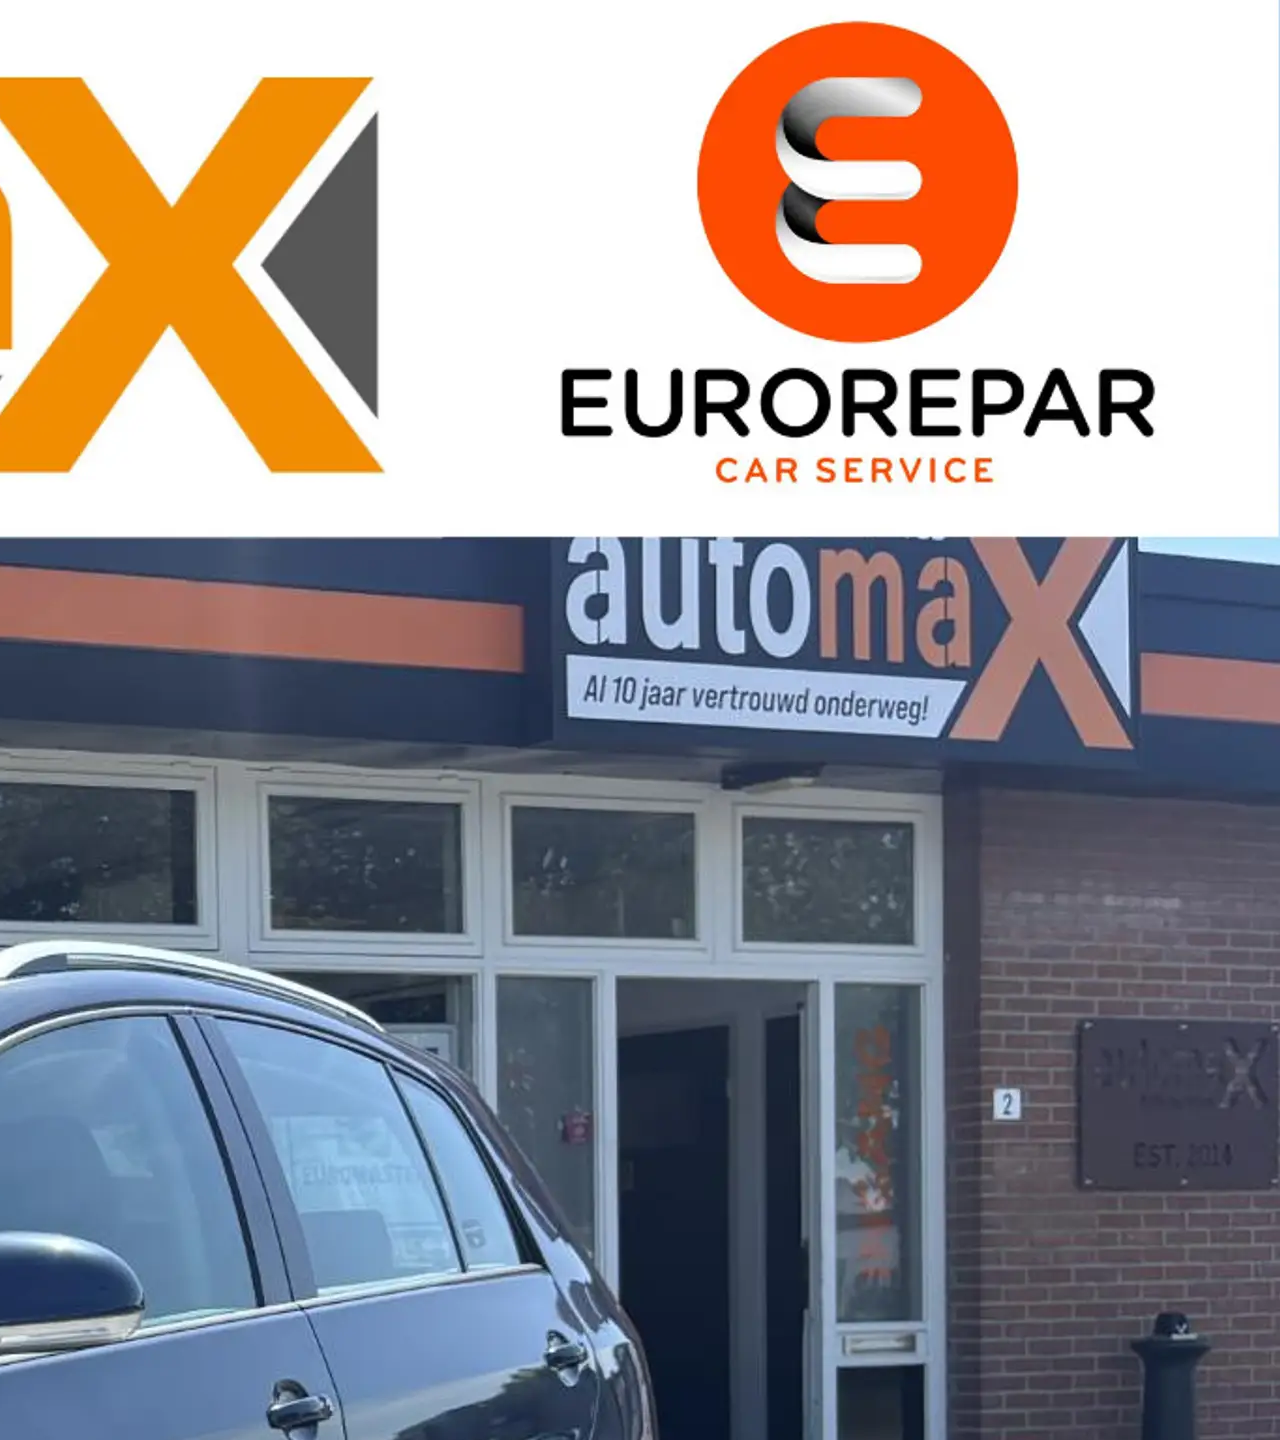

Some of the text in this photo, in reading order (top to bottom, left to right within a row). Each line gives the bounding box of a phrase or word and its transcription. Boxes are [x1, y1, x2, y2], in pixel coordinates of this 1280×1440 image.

[584, 675, 929, 726] Al 10 jaar vertrouwd onderweg!
[1002, 1093, 1013, 1115] 2
